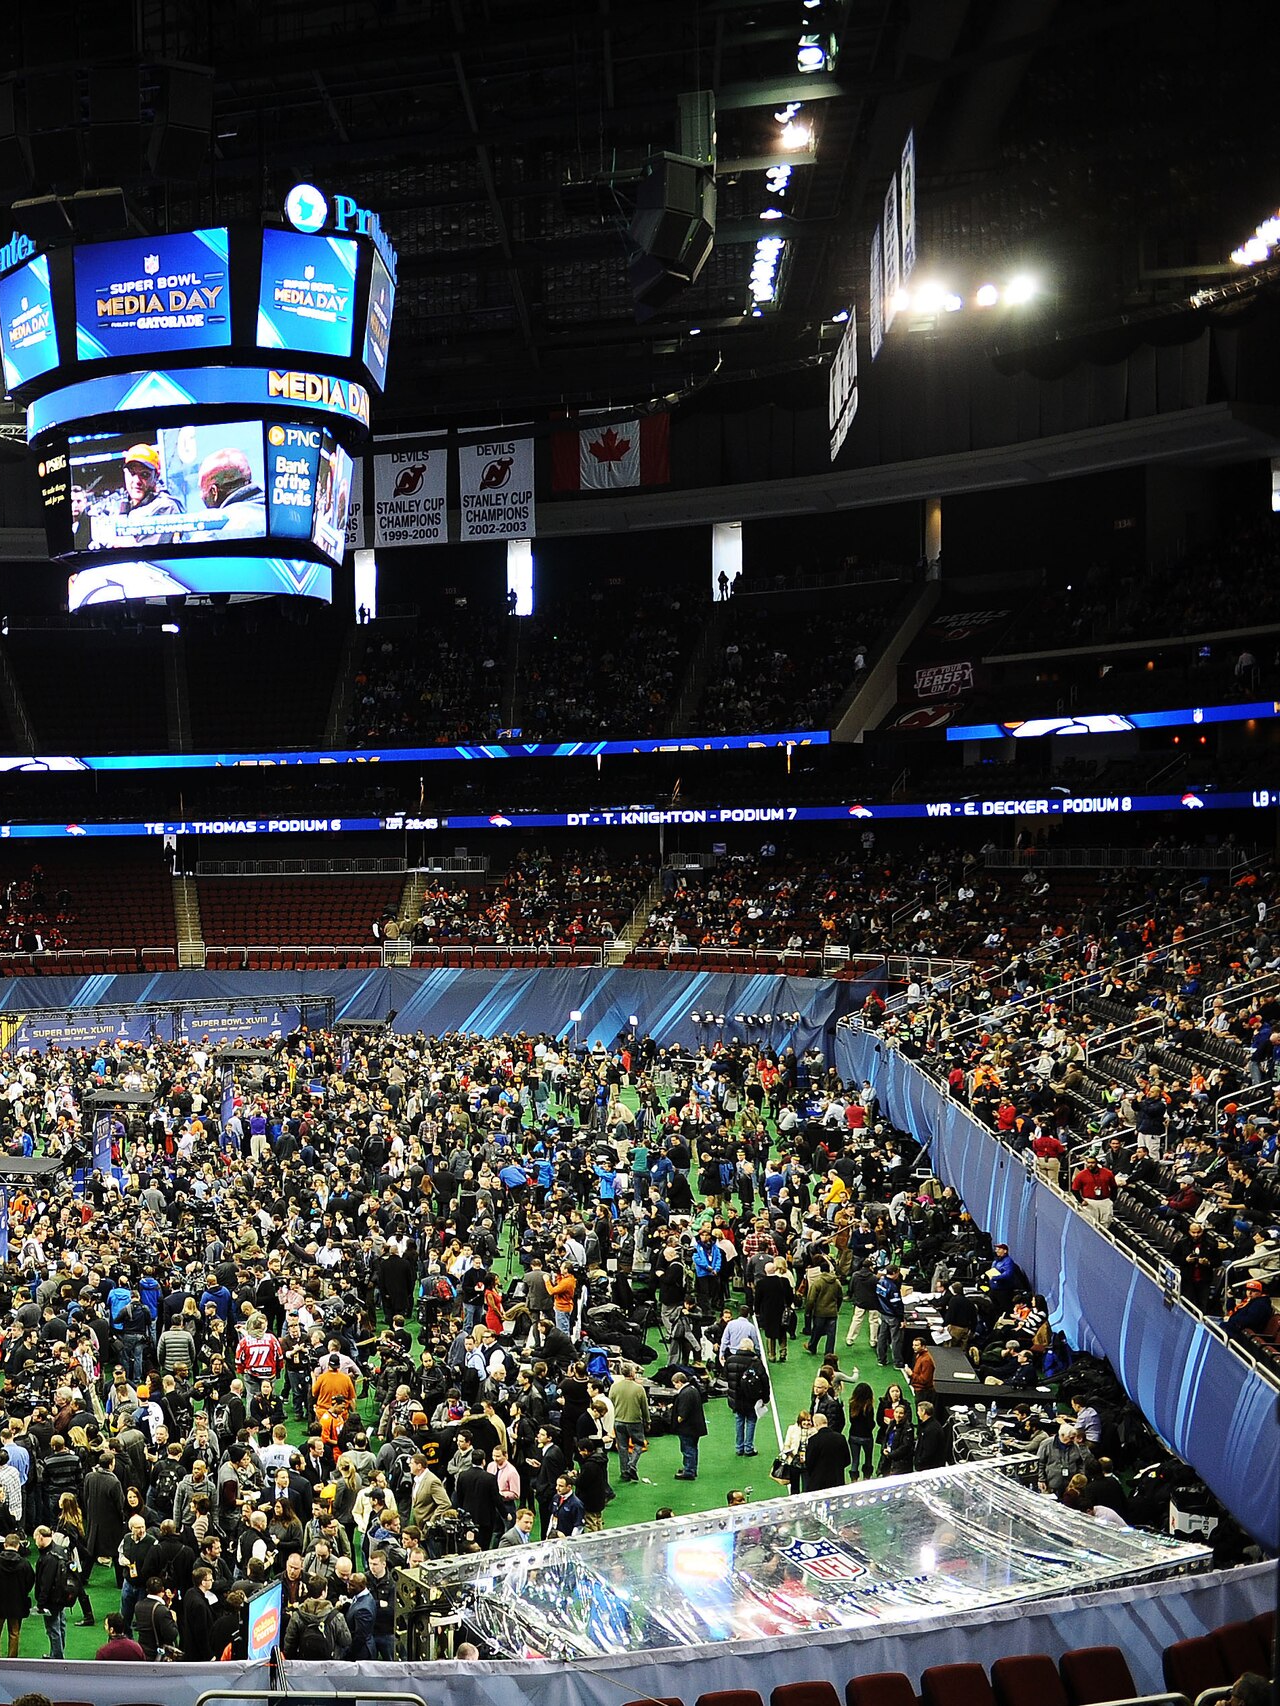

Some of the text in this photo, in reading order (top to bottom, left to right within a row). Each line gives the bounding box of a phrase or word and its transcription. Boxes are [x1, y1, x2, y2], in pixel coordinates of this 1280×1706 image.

[110, 273, 201, 295] SUPER BOWL
[97, 286, 223, 316] MEDIA DAY
[274, 288, 348, 312] MEDIA DAY
[9, 322, 31, 343] MEDIA
[32, 311, 50, 331] DAY
[137, 314, 204, 329] GATORADE
[269, 370, 346, 410] MEDIA
[286, 429, 320, 448] PNC
[391, 450, 429, 463] DEVILS
[477, 442, 516, 456] DEVILS
[276, 456, 310, 475] Bank
[275, 474, 310, 490] of the
[273, 488, 312, 507] Devils
[463, 491, 532, 508] STANLEY CUP
[376, 498, 445, 515] STANLEY CUP
[380, 513, 442, 529] CHAMPIONS
[466, 507, 529, 523] CHAMPIONS
[382, 528, 439, 542] 1999-2000
[469, 521, 527, 536] 2002-2003
[941, 664, 962, 674] YOUR
[914, 668, 974, 689] JERSEY
[931, 684, 946, 693] ON
[926, 803, 951, 816] WR
[964, 803, 979, 815] E.
[982, 800, 1048, 815] DECKER
[1063, 797, 1119, 812] PODIUM
[1121, 797, 1132, 811] 8
[1253, 791, 1269, 807] LB
[567, 813, 590, 826] DT
[603, 812, 618, 825] T.
[621, 810, 707, 824] KNIGHTON
[720, 808, 784, 822] PODIUM
[786, 807, 797, 820] 7
[1, 826, 10, 838] 5
[145, 823, 164, 835] TE
[176, 822, 189, 834] J.
[192, 821, 257, 833] THOMAS
[268, 820, 328, 832] PODIUM
[331, 819, 341, 831] 6
[191, 1016, 268, 1028] SUPER BOWL XLVIII
[33, 1025, 114, 1038] SUPER BOWL XLVIII
[249, 1346, 270, 1366] 77
[804, 1557, 861, 1577] NFL
